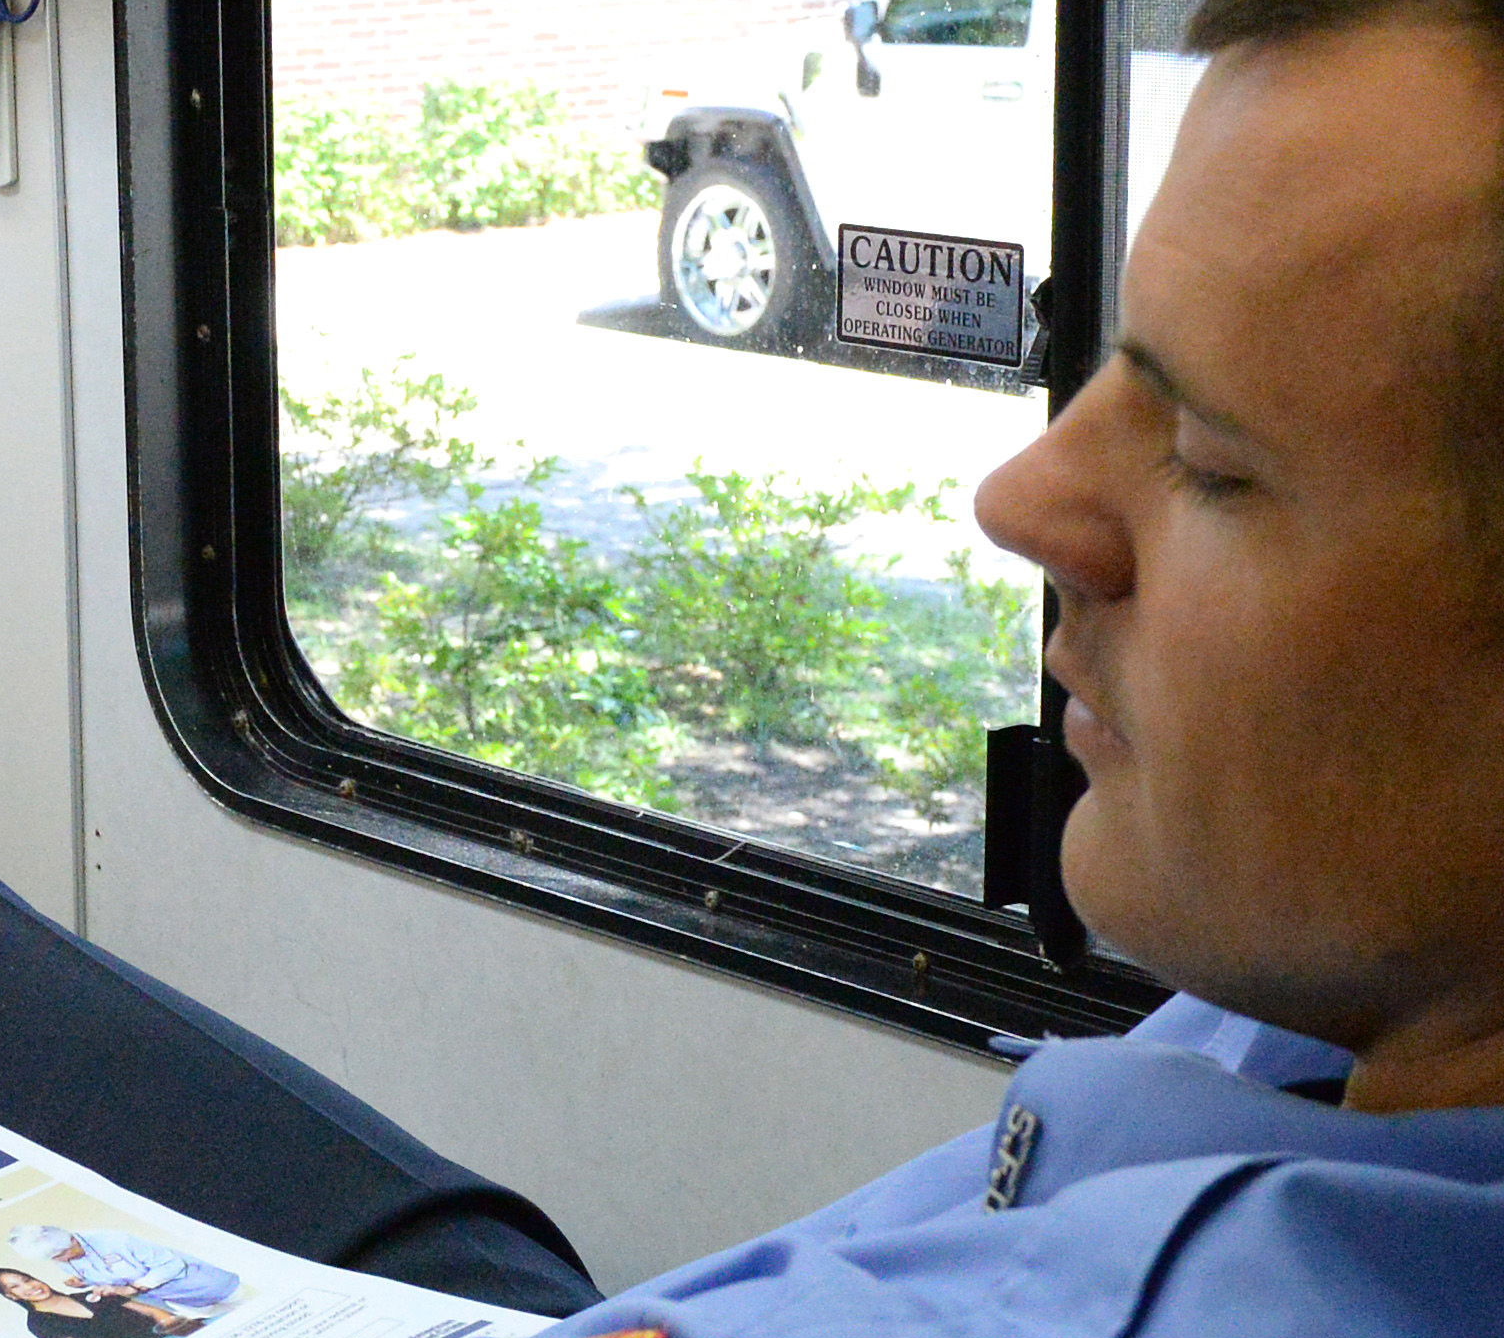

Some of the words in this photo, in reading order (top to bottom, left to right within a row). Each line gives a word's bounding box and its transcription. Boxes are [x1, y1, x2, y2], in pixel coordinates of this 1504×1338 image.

[850, 235, 1013, 287] CAUTION
[863, 276, 926, 299] WINDOW
[931, 285, 971, 304] MUST
[976, 291, 996, 308] BE
[876, 300, 933, 322] CLOSED
[938, 309, 982, 329] WHEN
[844, 317, 923, 344] OPERATING
[927, 329, 1016, 357] GENERATOR
